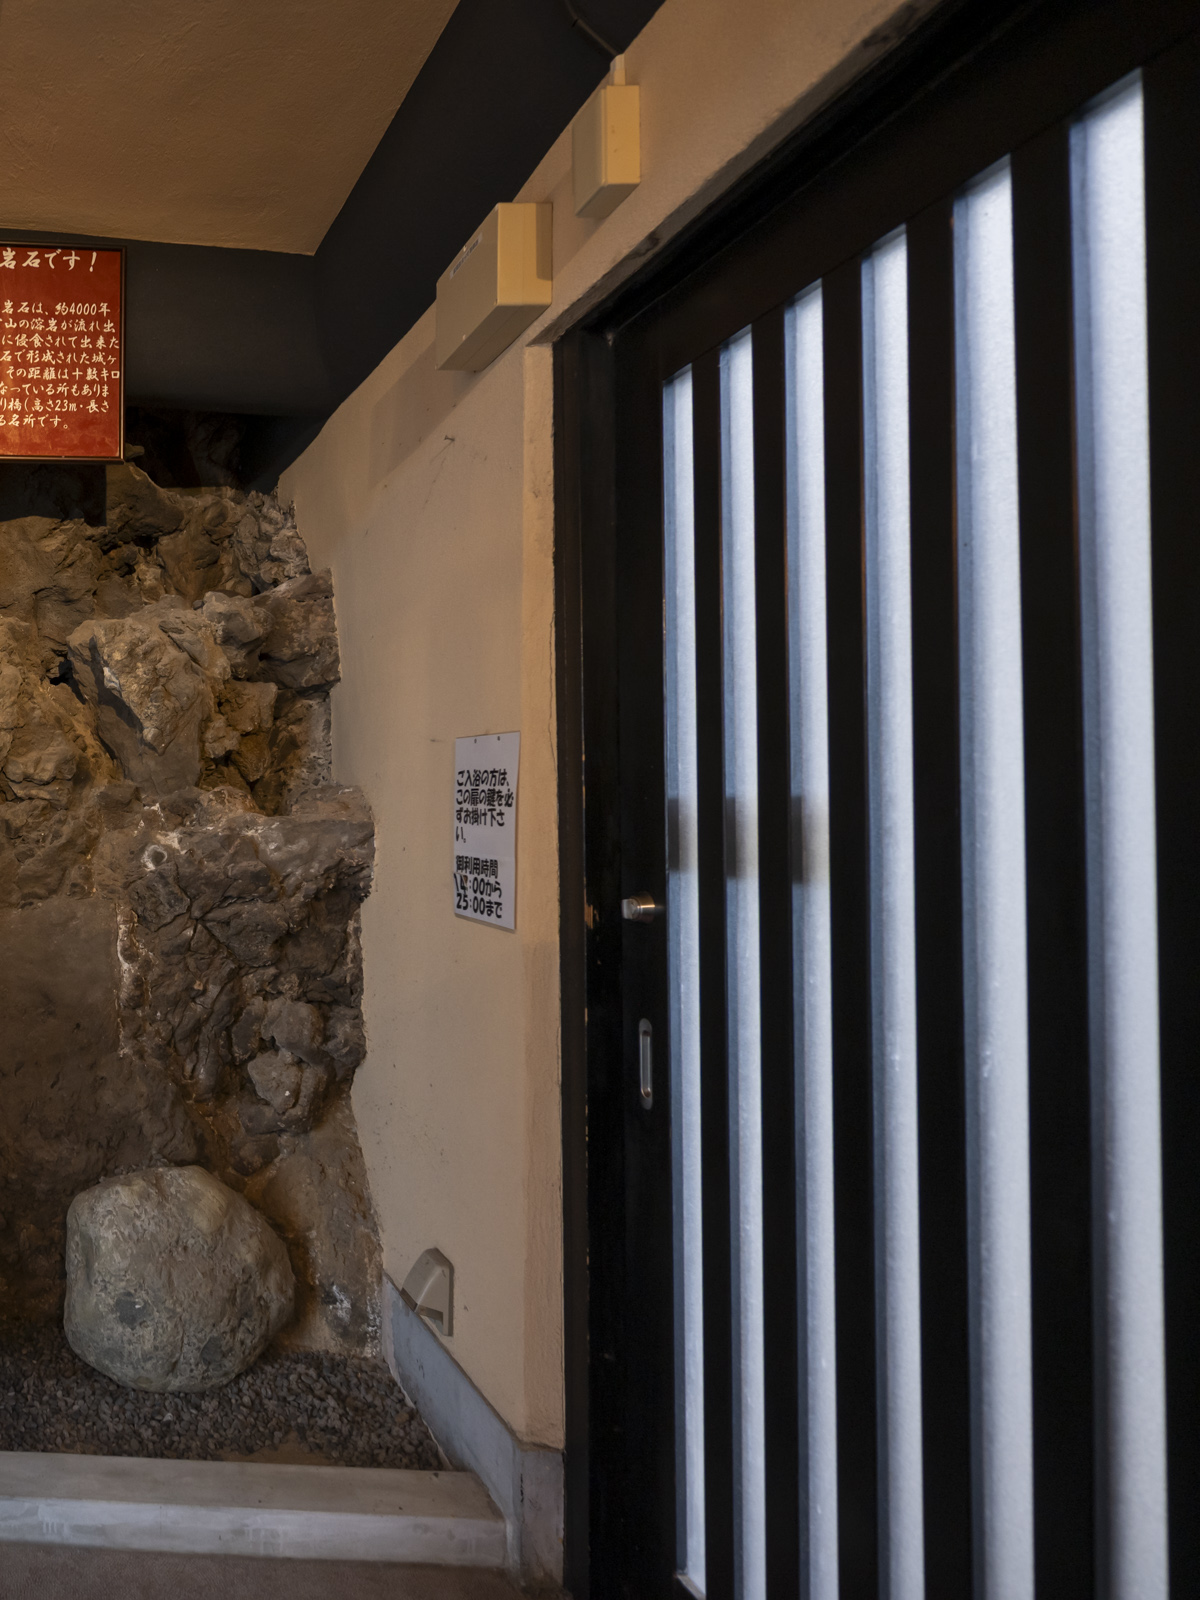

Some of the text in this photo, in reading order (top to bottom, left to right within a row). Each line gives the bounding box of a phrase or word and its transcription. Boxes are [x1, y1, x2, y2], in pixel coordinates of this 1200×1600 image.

[456, 768, 511, 787] ご入浴の方は、
[455, 788, 514, 808] この扉の鍵を必
[455, 808, 505, 827] ずお掛け下さ
[455, 827, 467, 843] い。
[455, 855, 499, 879] 御利用時間
[456, 892, 503, 919] 25:00まで
